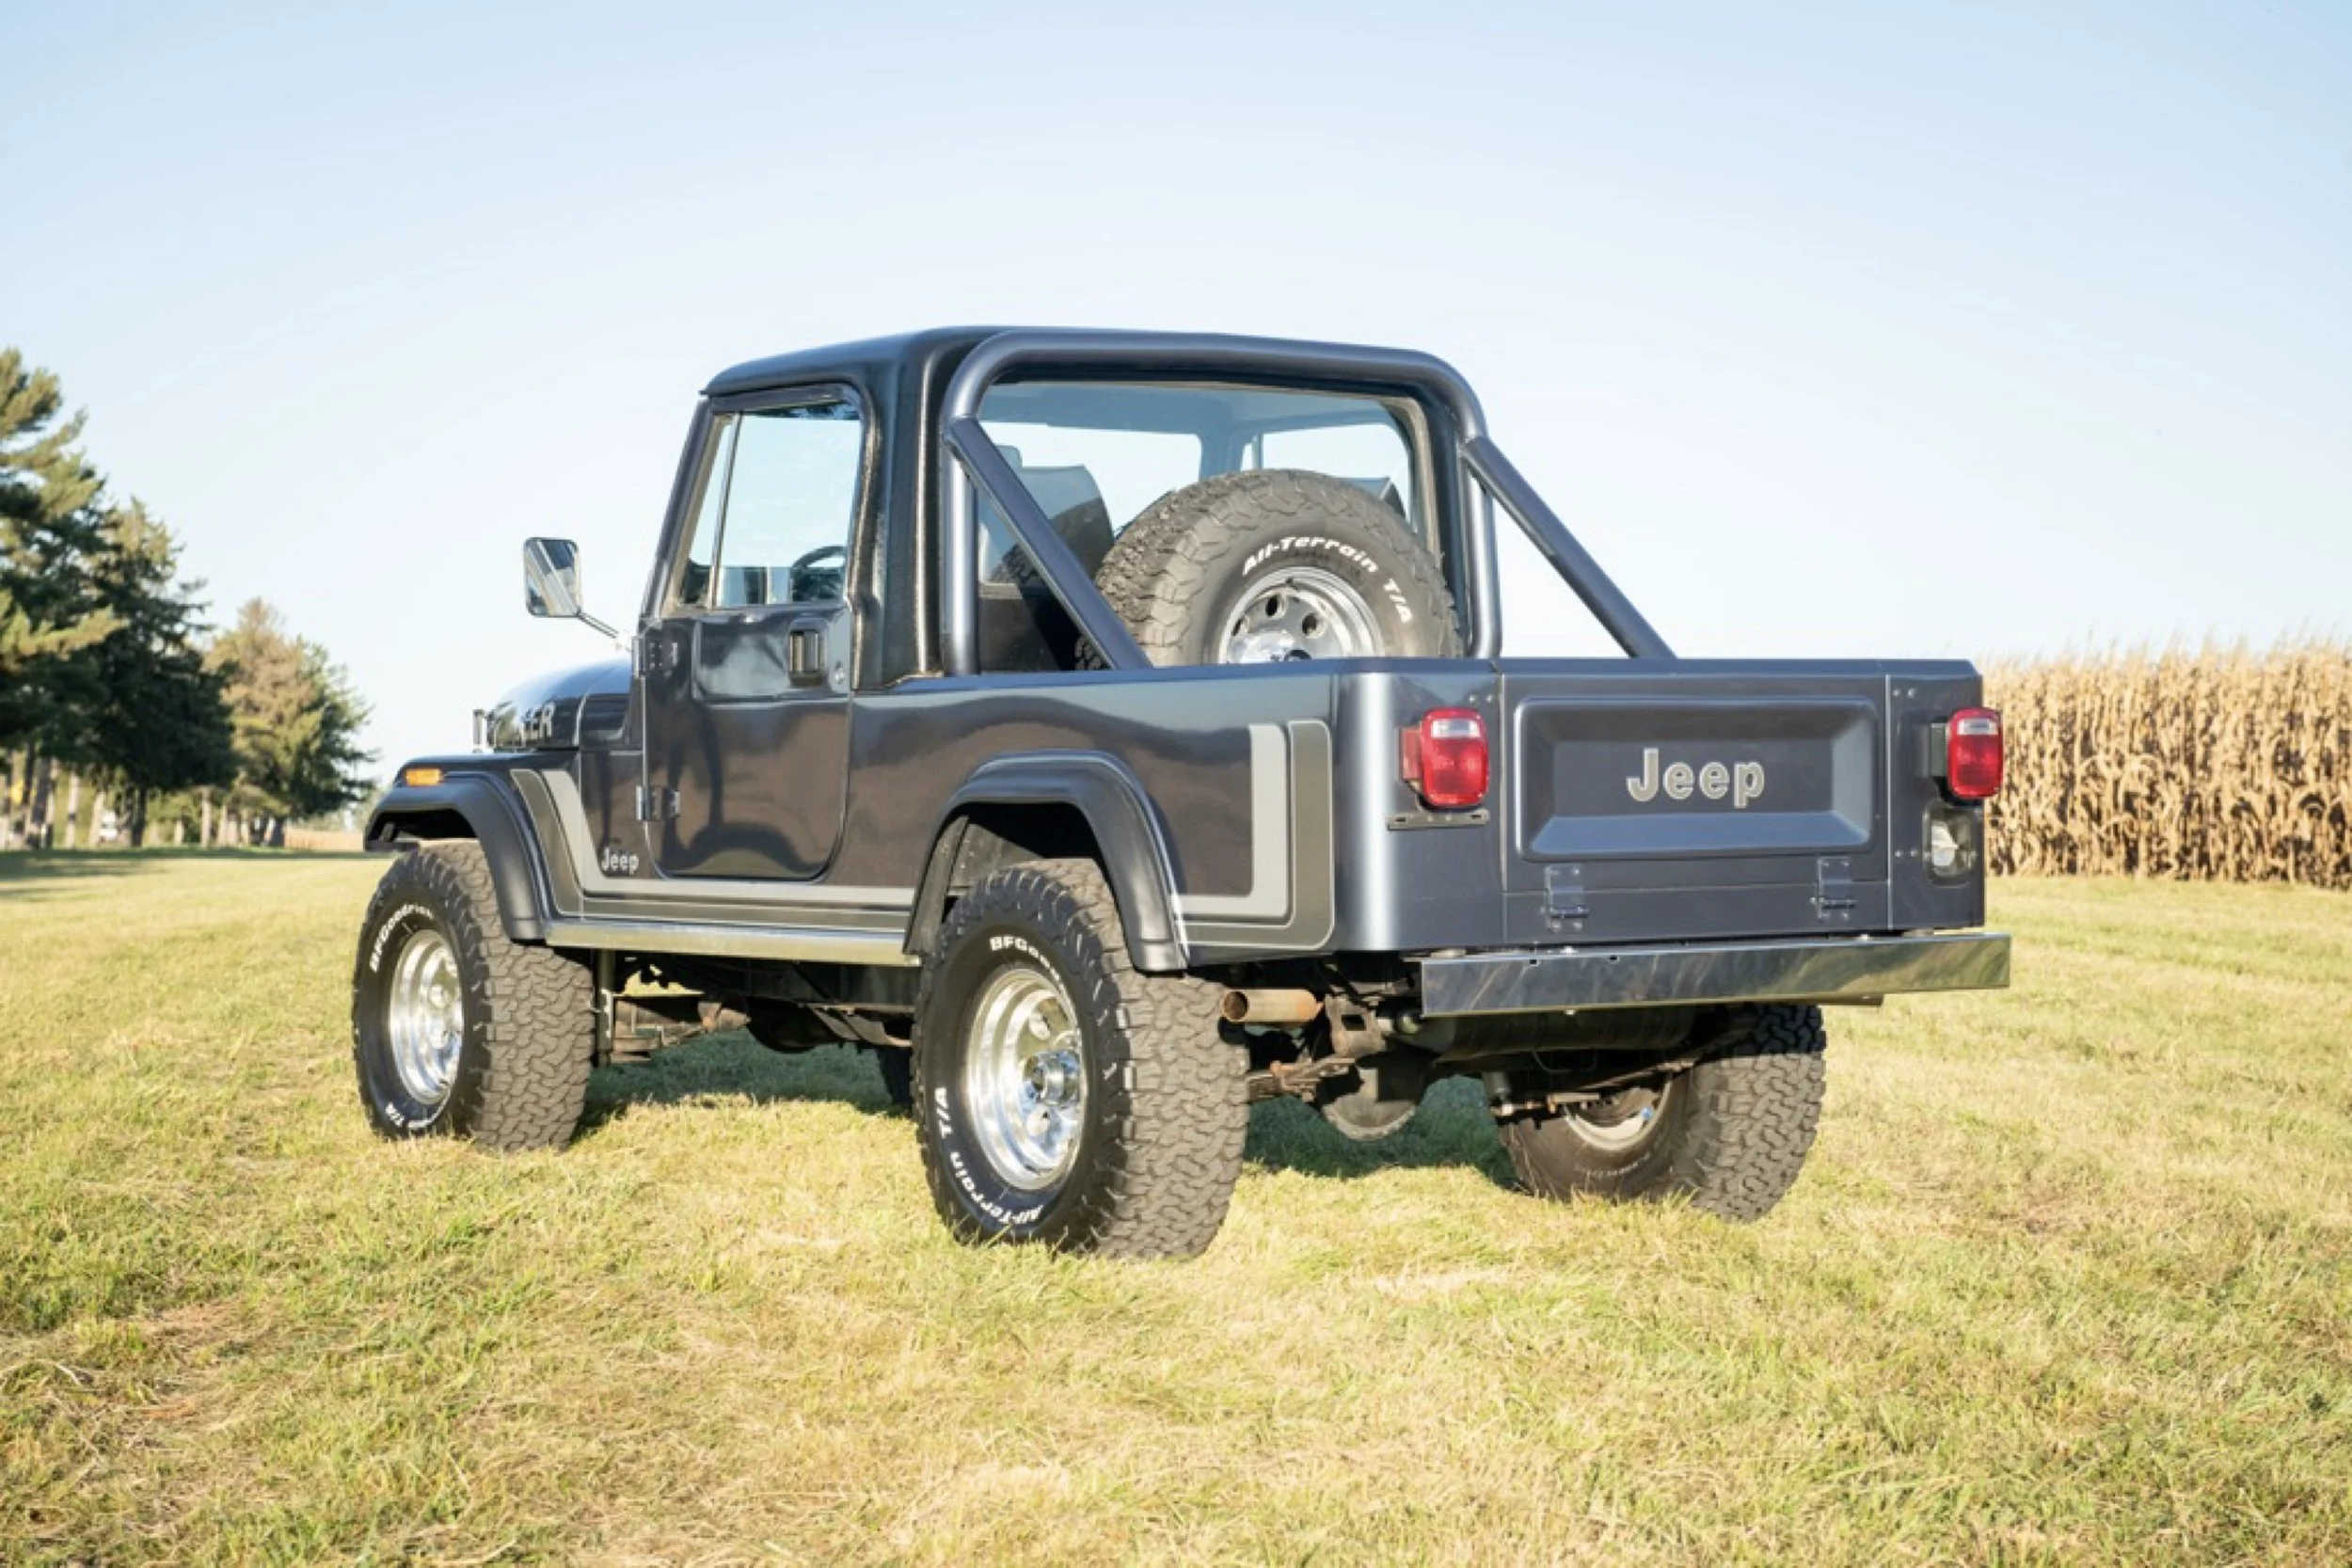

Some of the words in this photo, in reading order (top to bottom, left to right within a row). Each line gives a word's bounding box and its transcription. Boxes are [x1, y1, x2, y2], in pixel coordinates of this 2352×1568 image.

[1242, 536, 1379, 577] All-Terrain
[1626, 748, 1765, 809] Jeep
[601, 847, 640, 877] Jeep
